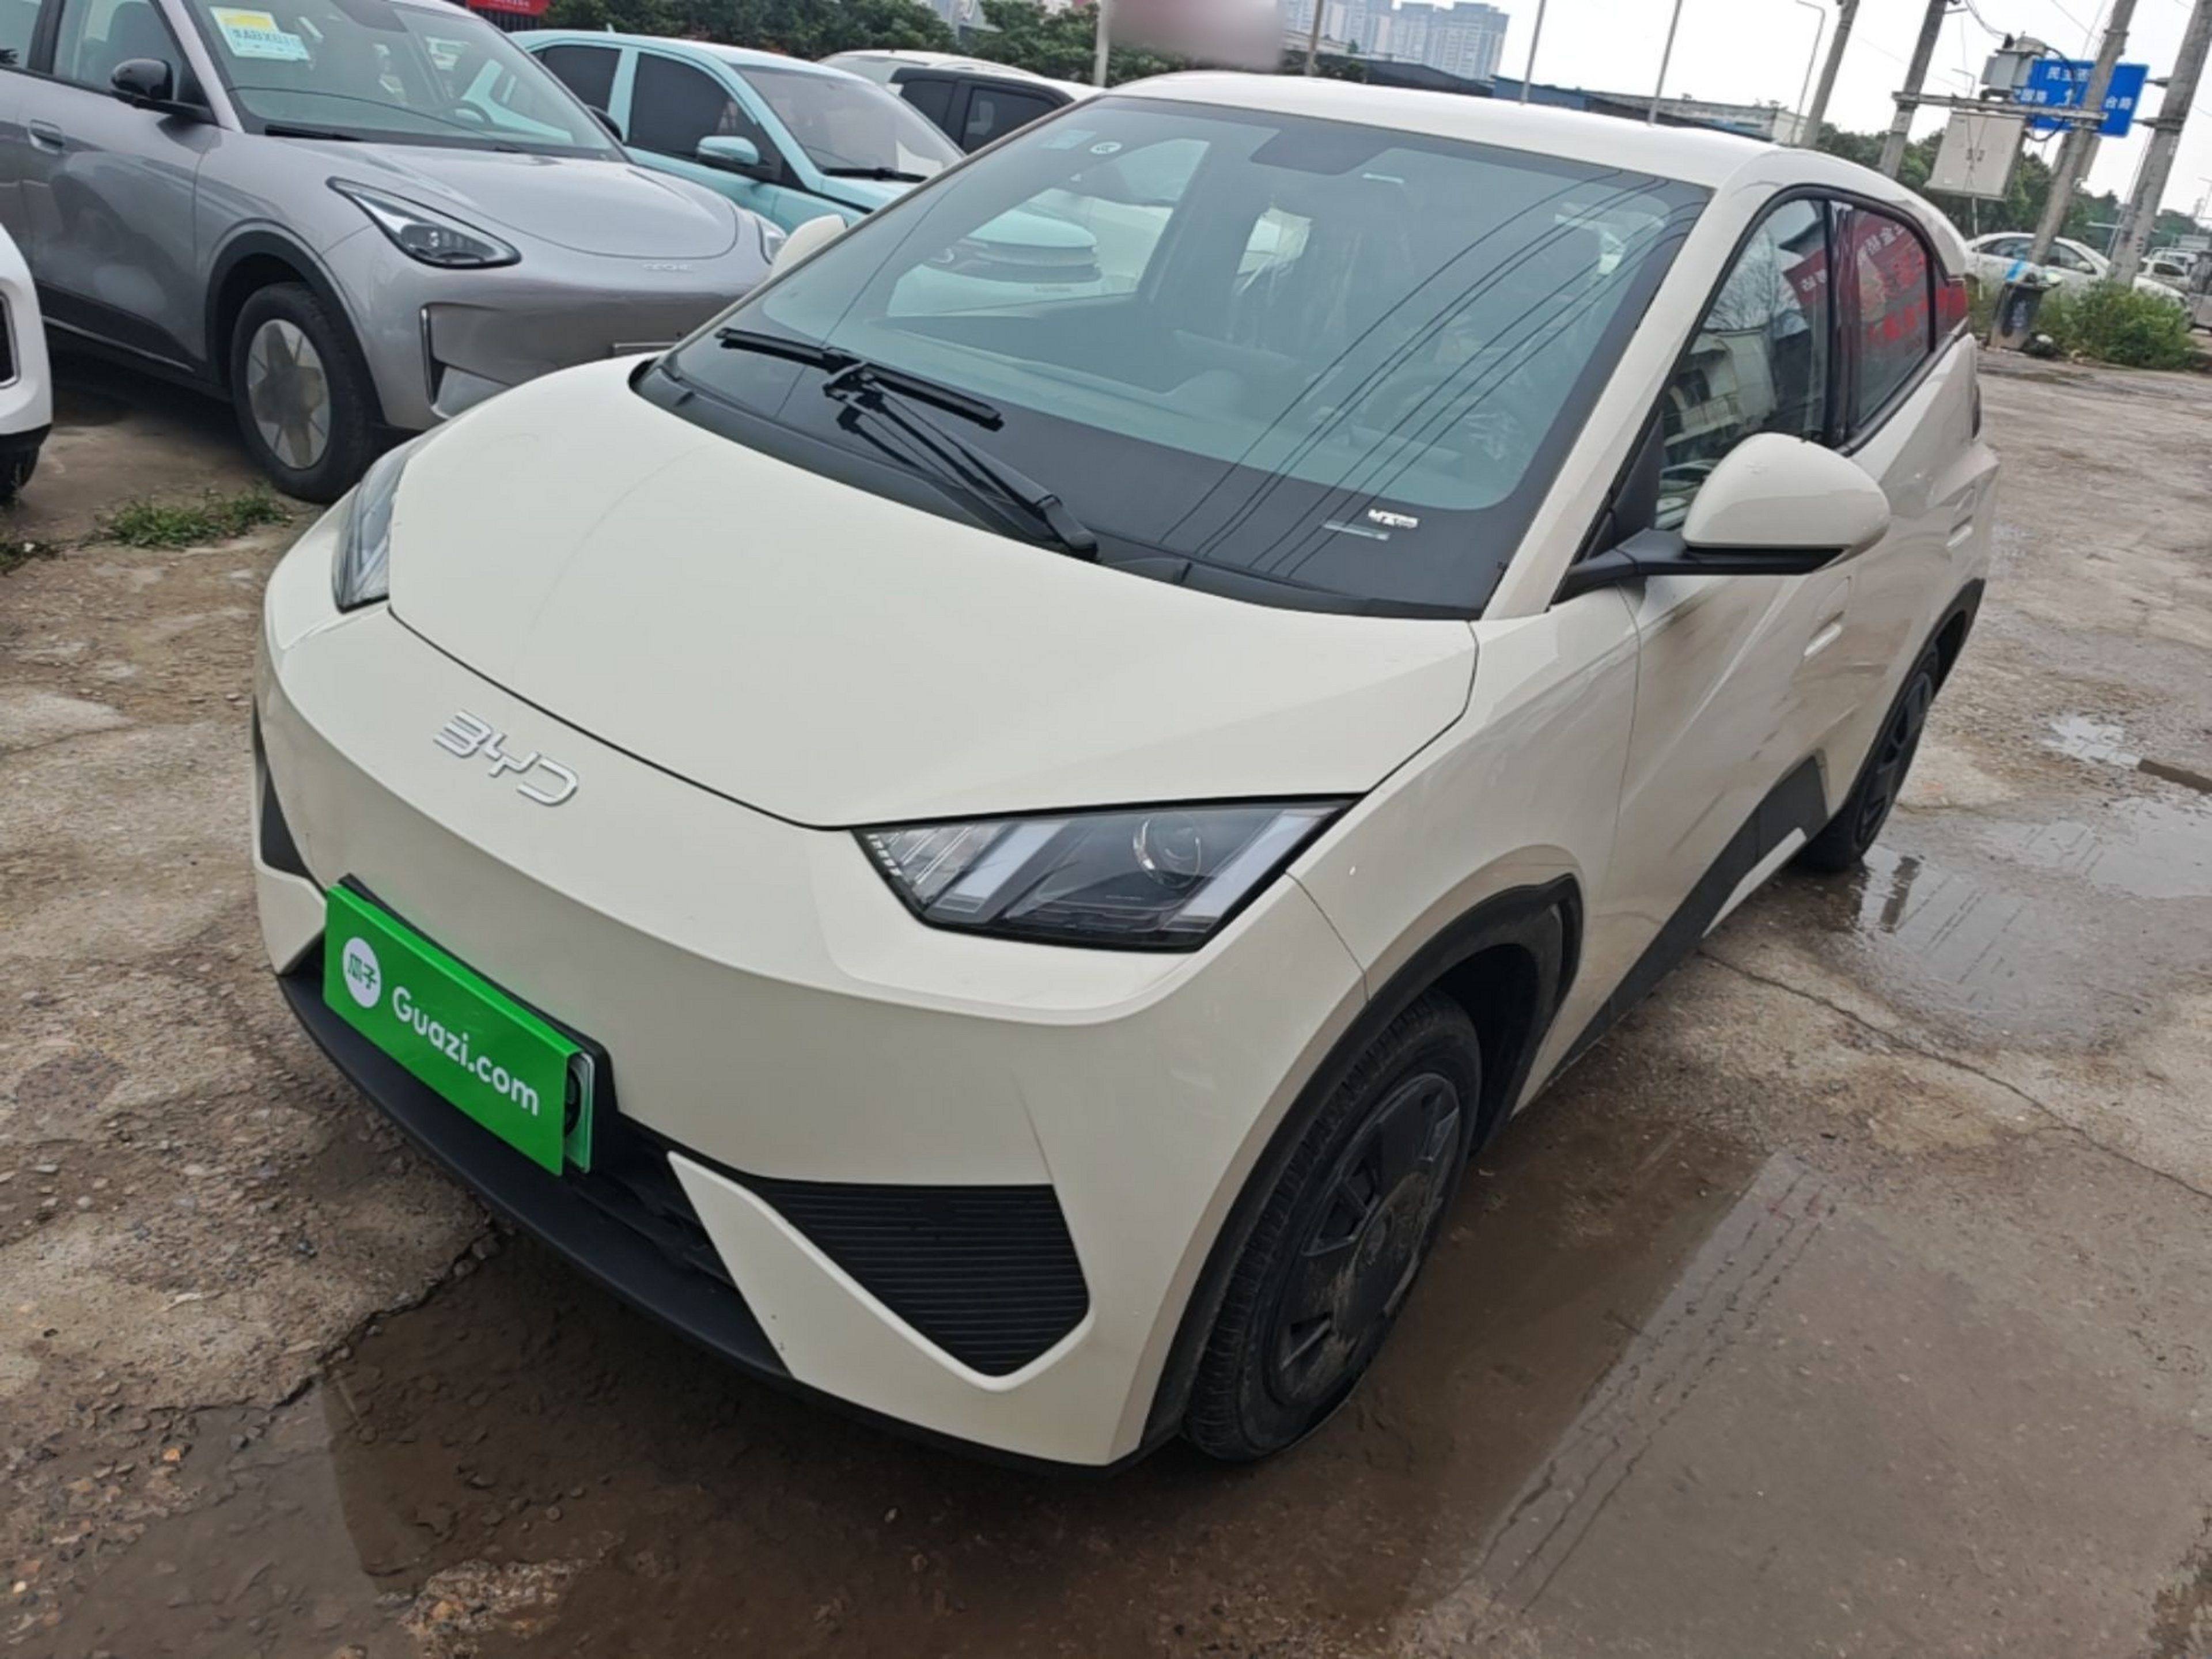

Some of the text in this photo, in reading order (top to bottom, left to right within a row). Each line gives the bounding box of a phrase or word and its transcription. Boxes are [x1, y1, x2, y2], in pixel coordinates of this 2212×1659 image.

[433, 709, 578, 806] BYD
[347, 952, 377, 990] 瓜子
[392, 986, 540, 1116] Guazi.com
